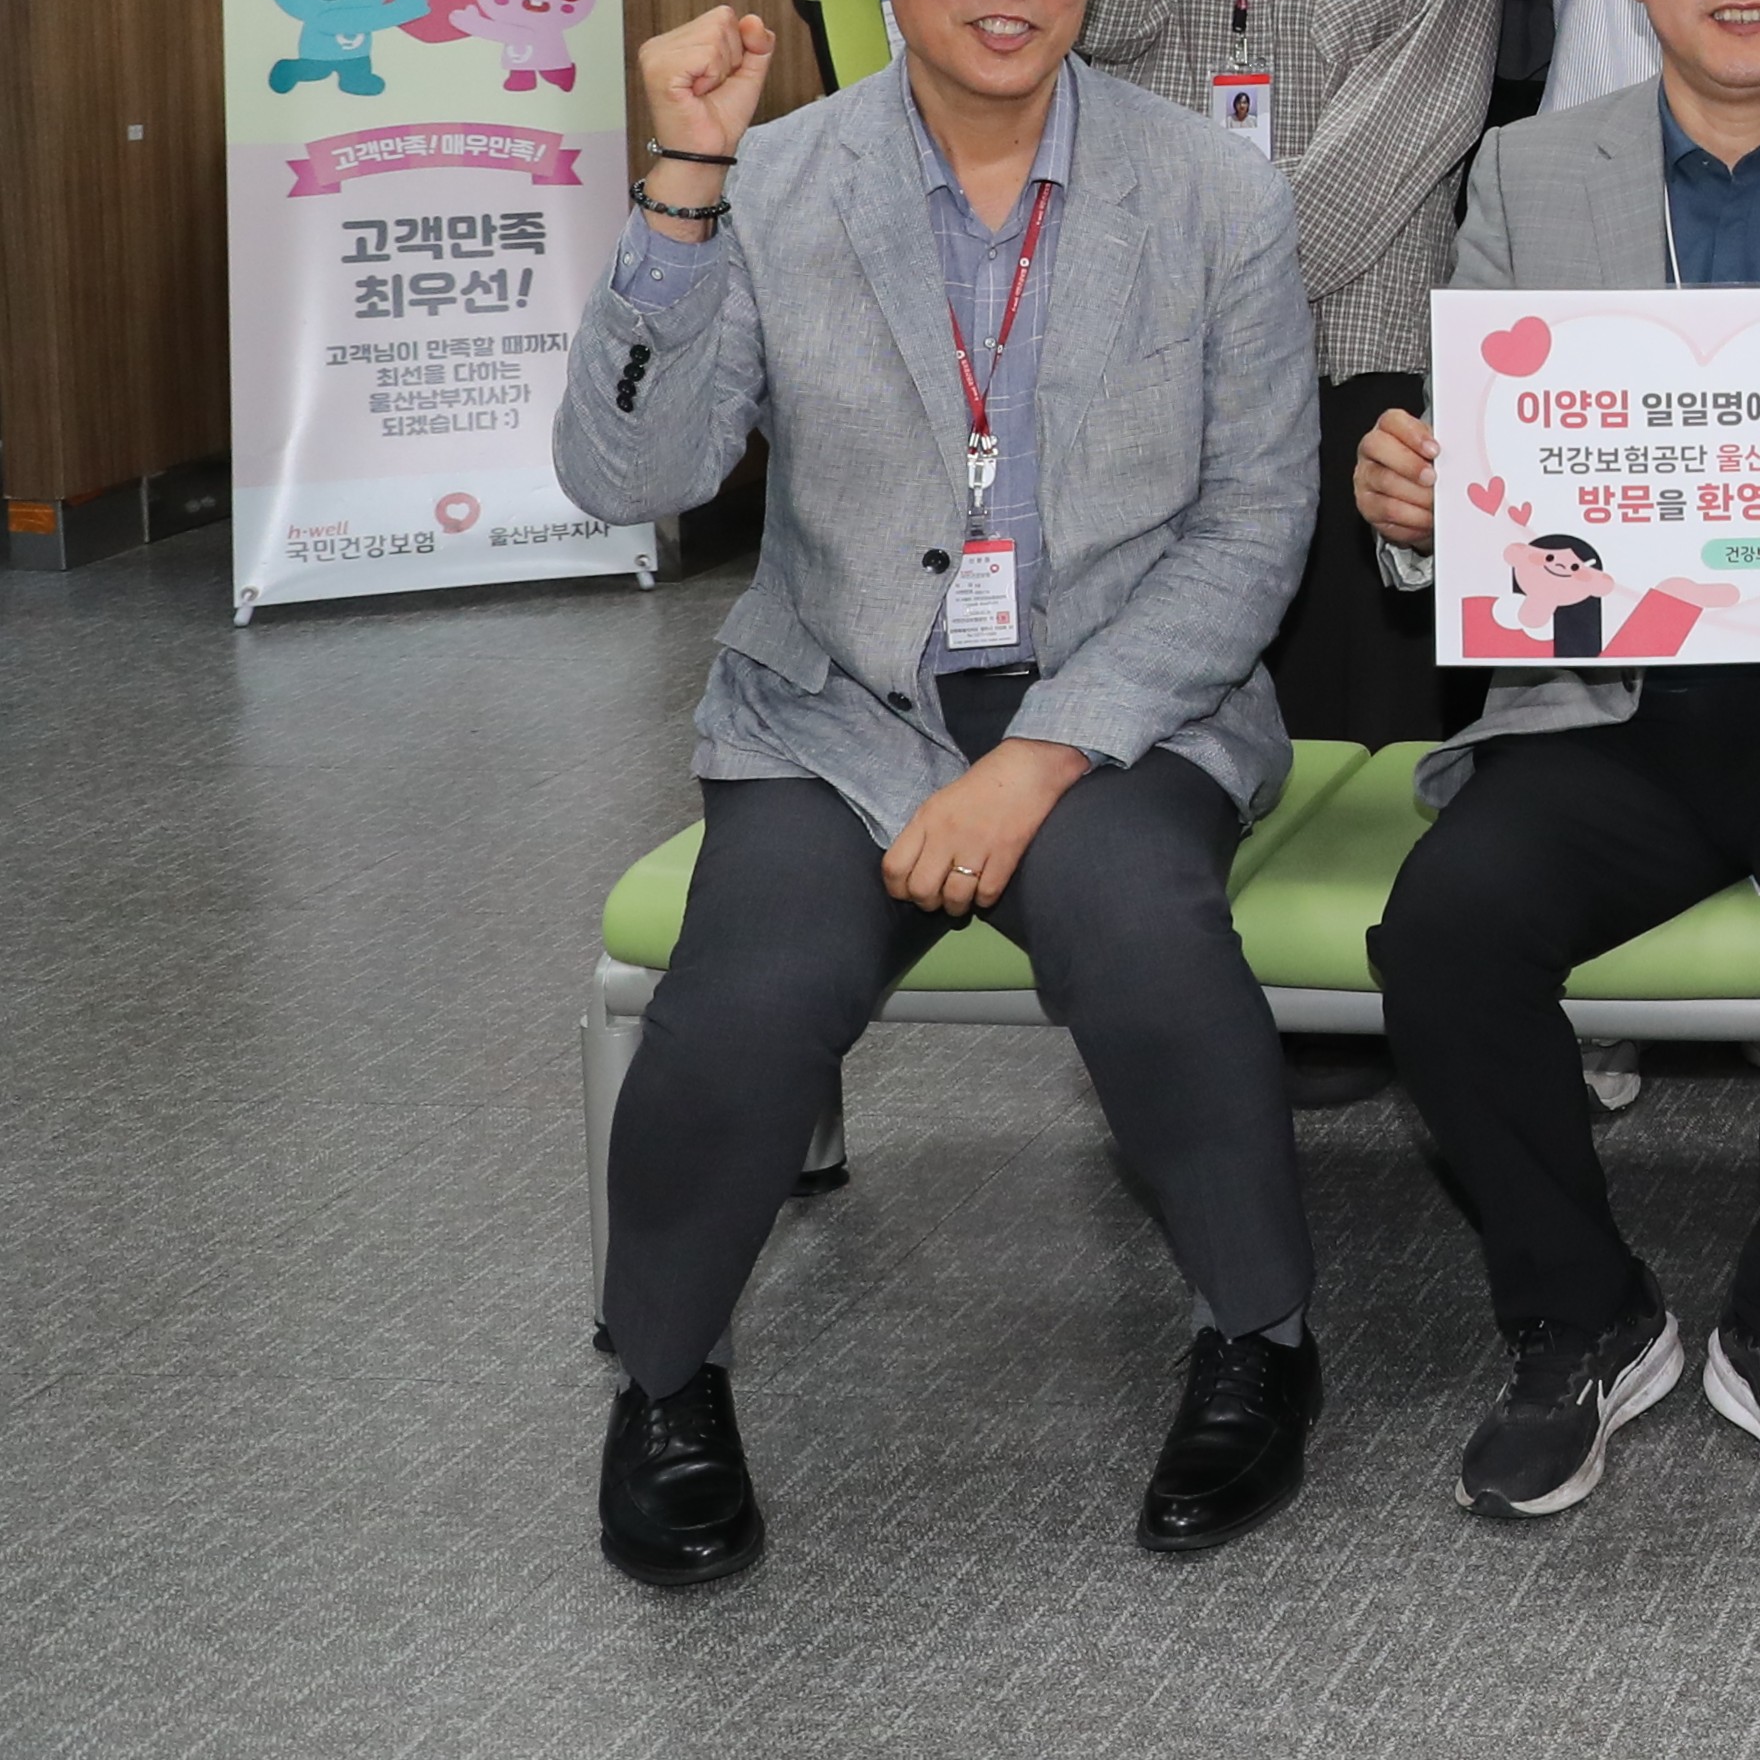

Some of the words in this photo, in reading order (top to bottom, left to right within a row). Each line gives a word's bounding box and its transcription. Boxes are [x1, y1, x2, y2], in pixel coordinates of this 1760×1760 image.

[330, 134, 438, 172] 고객만족!
[440, 132, 547, 164] 매우만족!
[340, 212, 547, 264] 고객만족
[354, 267, 535, 320] 최우선!
[325, 341, 420, 367] 고객님이
[426, 336, 495, 361] 만족할
[501, 332, 568, 356] 때까지
[376, 364, 447, 388] 최선을
[453, 360, 522, 383] 다하는
[368, 384, 531, 413] 울산남부지사가
[1515, 388, 1629, 430] 이양임
[381, 412, 502, 439] 되겠습니다
[1538, 445, 1707, 476] 건강보험공단
[1577, 484, 1688, 525] 방문을
[284, 530, 436, 564] 국민건강보험
[488, 520, 610, 546] 울산남부지사
